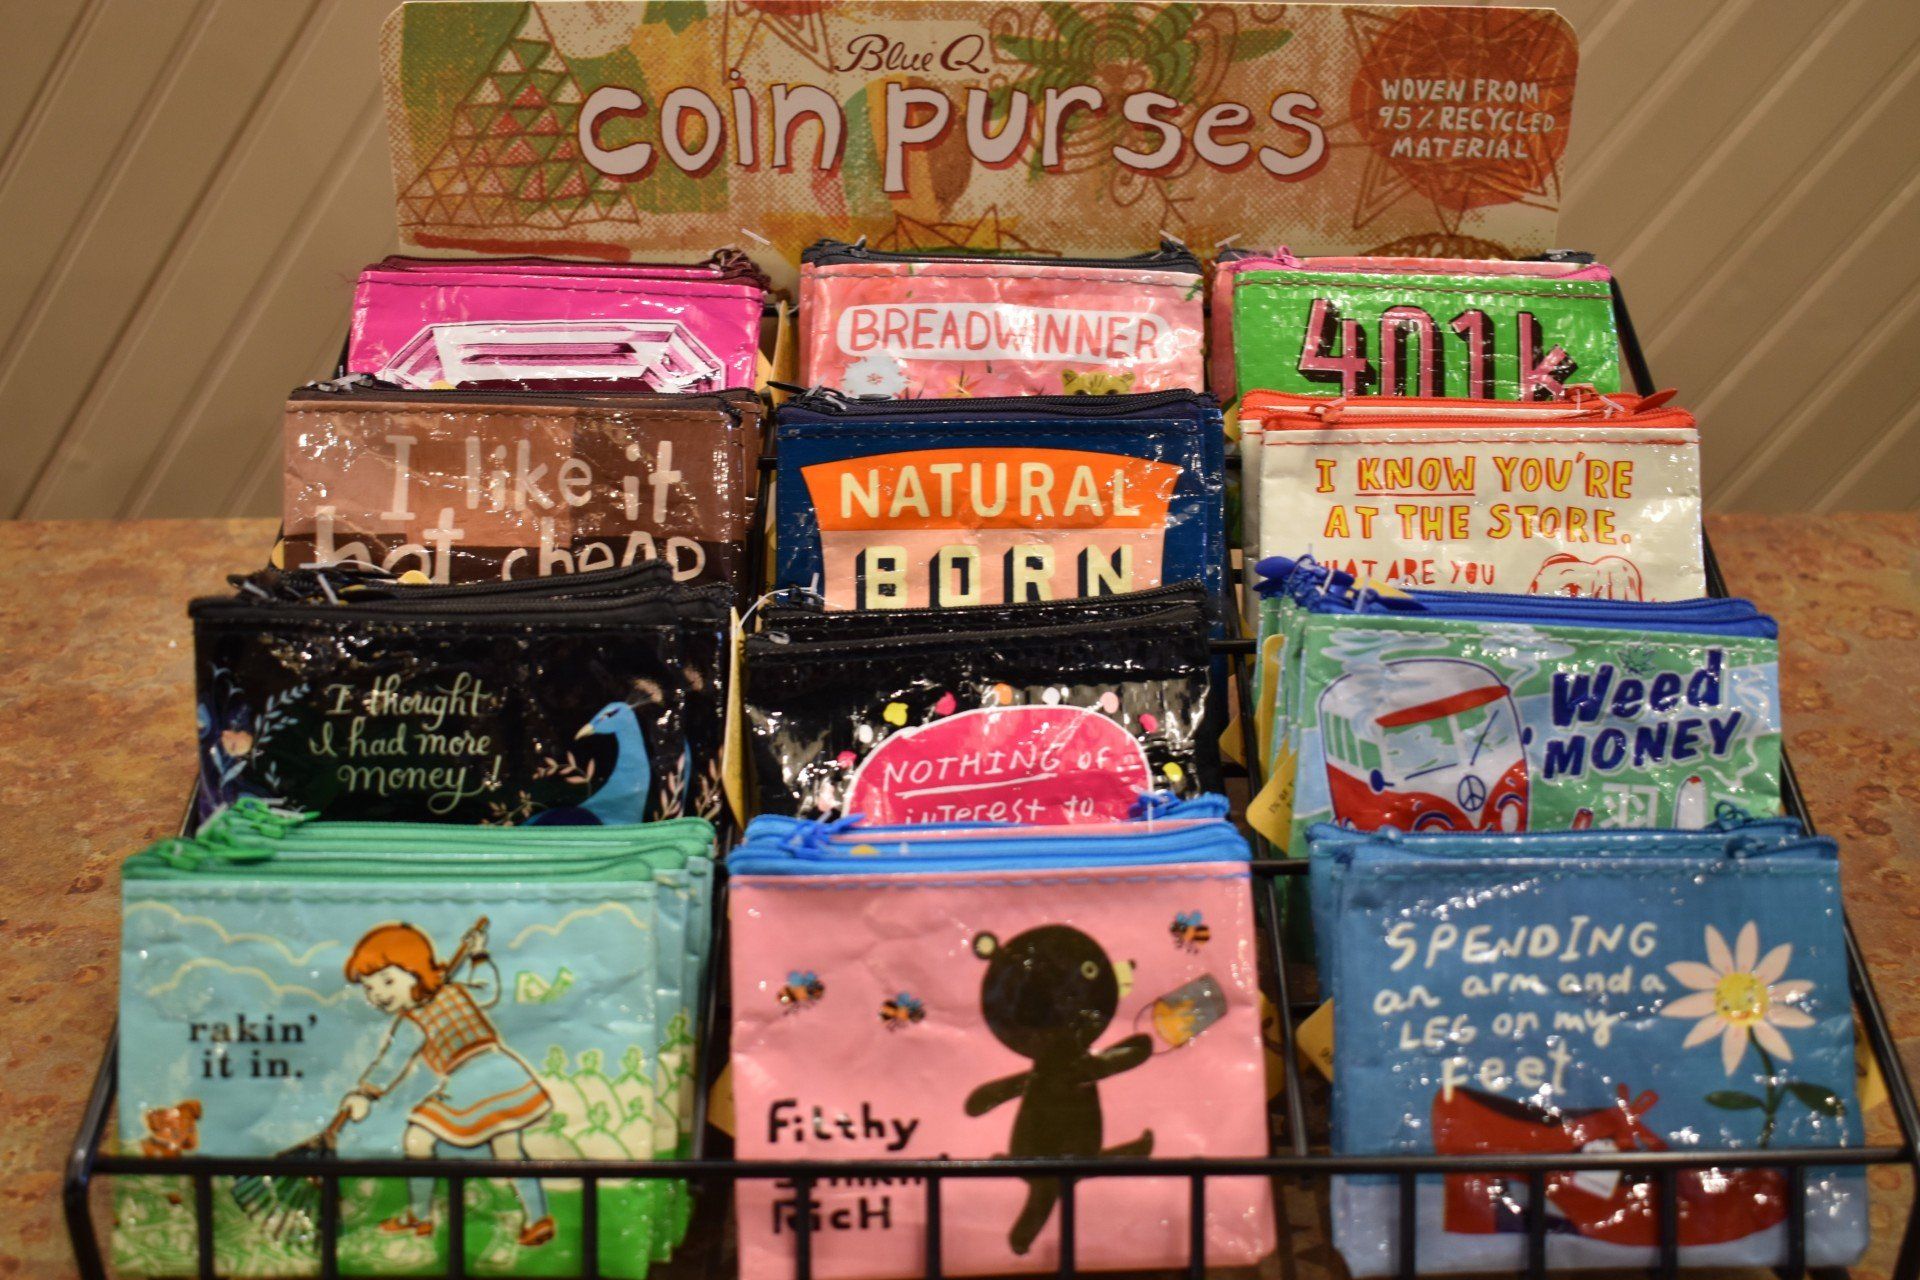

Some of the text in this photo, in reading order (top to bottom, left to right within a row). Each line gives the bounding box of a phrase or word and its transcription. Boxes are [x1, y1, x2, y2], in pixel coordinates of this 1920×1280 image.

[833, 33, 990, 75] Blue Q
[1381, 78, 1539, 104] WOVEN FROM
[579, 68, 1326, 194] coin purses
[1378, 106, 1556, 133] 95% RECYCLED
[1390, 136, 1528, 159] MATERIAL
[850, 308, 1160, 358] BREADWINNER
[1298, 298, 1578, 400] 401k
[380, 435, 681, 524] I like it
[840, 462, 1141, 519] NATURAL
[1315, 451, 1634, 499] I KNOW YOU'RE
[315, 506, 464, 584] hot
[1324, 503, 1634, 545] AT THE STORE.
[856, 545, 1134, 610] BORN
[1316, 558, 1495, 585] AT ARE YOU
[324, 671, 492, 732] I thought
[1552, 649, 1721, 727] Weed
[308, 716, 492, 758] I had more
[1543, 711, 1742, 780] MONEY
[882, 744, 1060, 793] NOTHING
[1064, 796, 1095, 818] to
[1385, 915, 1658, 972] SPENDING
[1372, 985, 1441, 1015] an
[1461, 965, 1666, 997] arm and a
[188, 1014, 318, 1044] rakin'
[1400, 1008, 1621, 1051] LEG on my
[202, 1053, 305, 1079] it in.
[767, 1097, 920, 1152] Filthy
